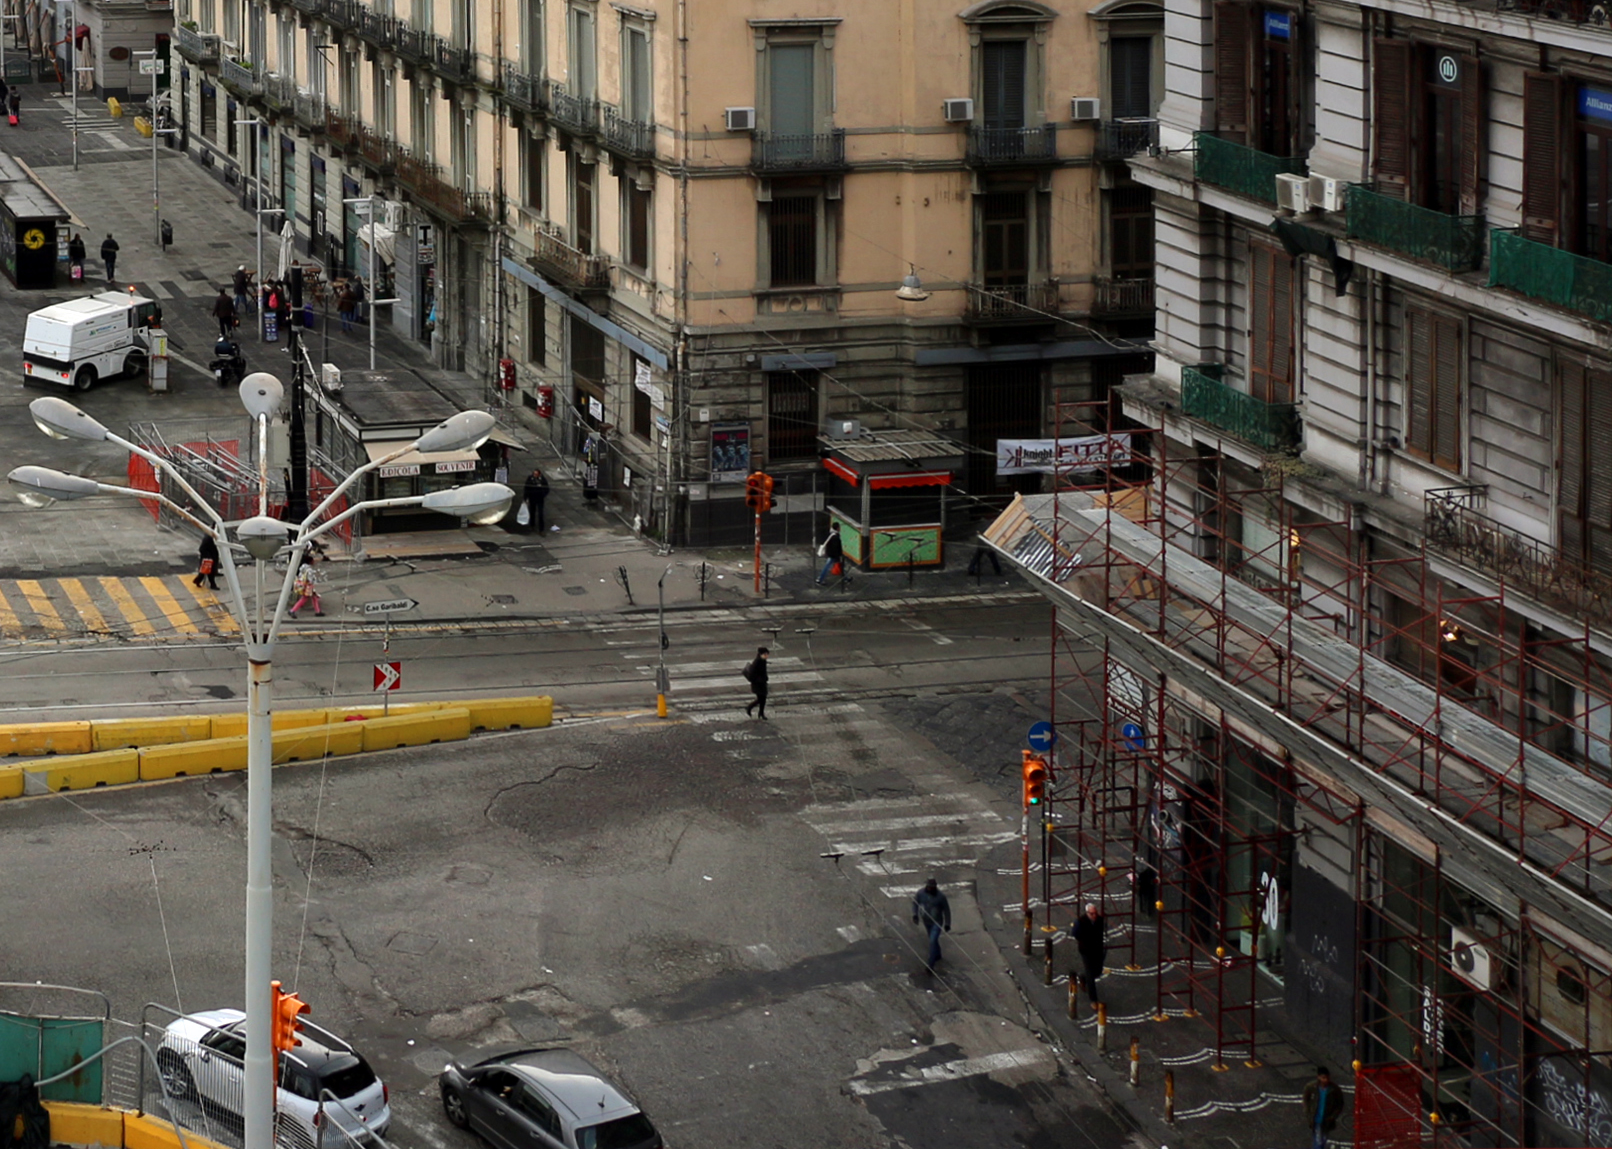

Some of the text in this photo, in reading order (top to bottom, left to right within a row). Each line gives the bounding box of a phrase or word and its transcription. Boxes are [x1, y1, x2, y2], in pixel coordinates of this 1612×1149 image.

[419, 225, 432, 246] T
[381, 467, 419, 477] EDICOLA
[437, 461, 474, 472] SOUVENIR
